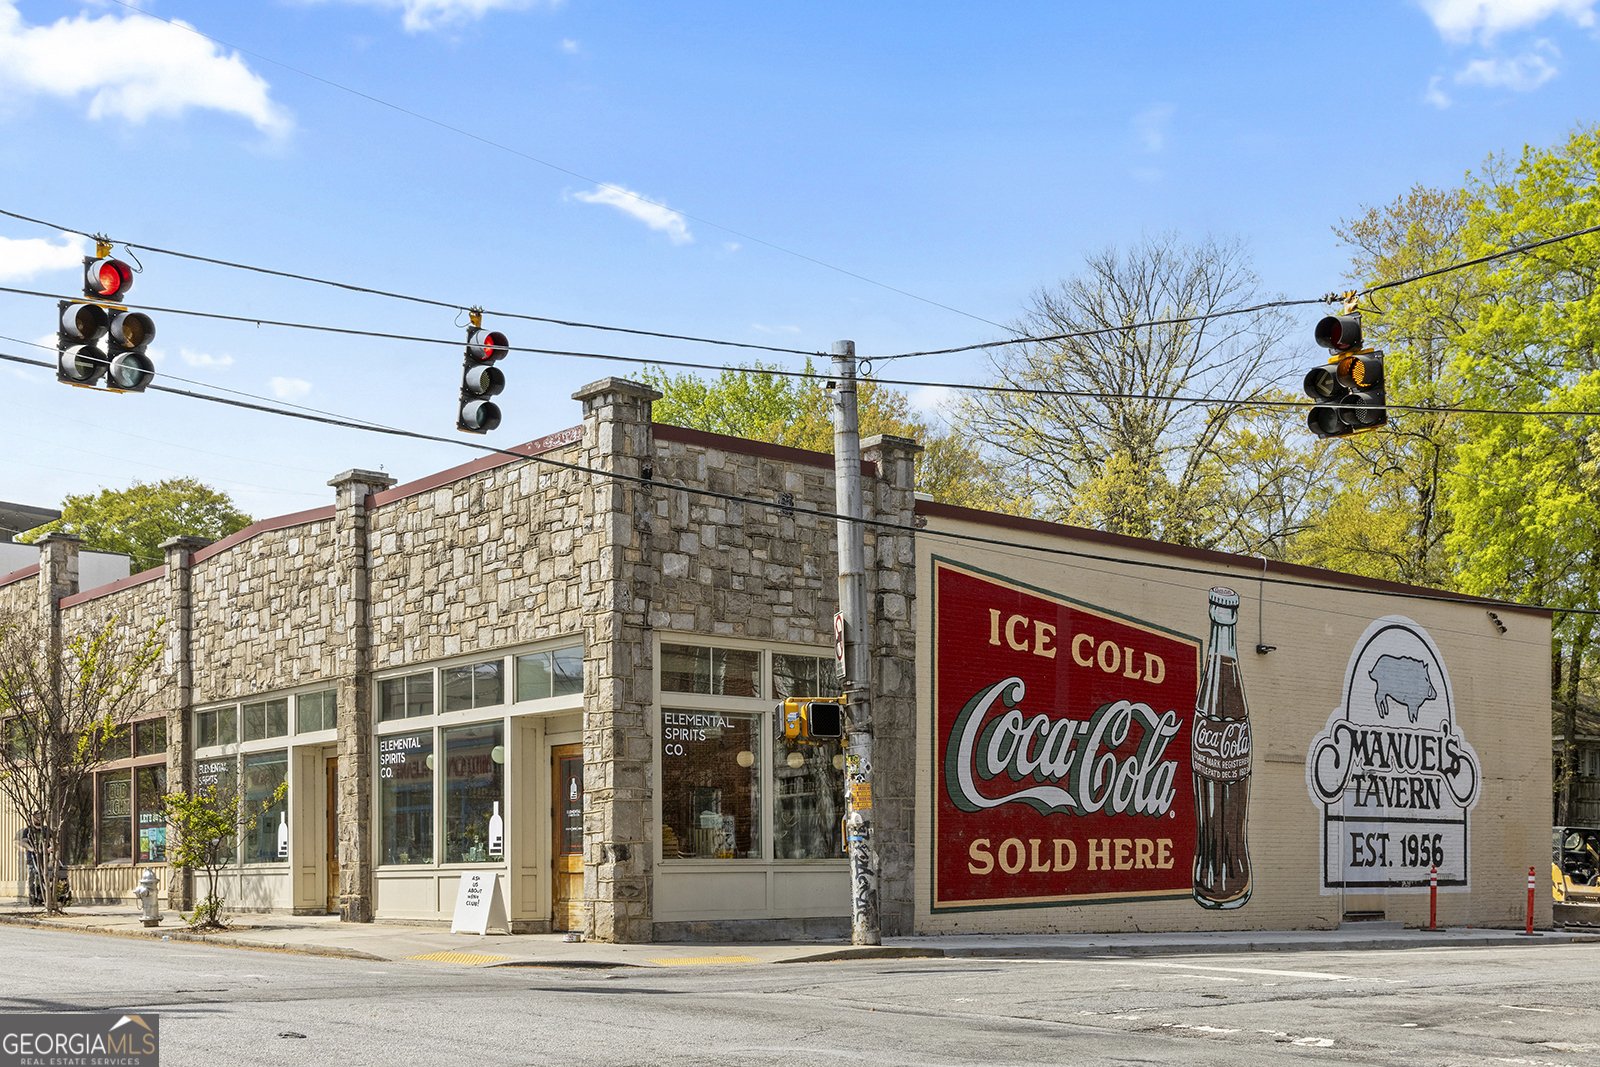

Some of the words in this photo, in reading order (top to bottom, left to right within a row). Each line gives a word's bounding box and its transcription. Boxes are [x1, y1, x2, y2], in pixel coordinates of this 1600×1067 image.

[989, 608, 1057, 659] ICE
[1071, 633, 1166, 684] COLD
[664, 712, 735, 729] ELEMENTAL
[664, 727, 706, 741] SPIRITS
[1194, 719, 1251, 759] Coca-Cola
[380, 737, 421, 752] ELEMENTAL
[664, 743, 687, 756] CO.
[957, 676, 1183, 813] Coca-Cola
[380, 752, 406, 765] SPIRITS
[1206, 757, 1220, 768] MARK
[380, 767, 394, 779] CO.
[1351, 774, 1441, 810] TAVERN
[968, 838, 1077, 875] SOLD
[1087, 838, 1175, 871] HERE
[1349, 832, 1393, 868] EST.
[1400, 833, 1444, 868] 1956
